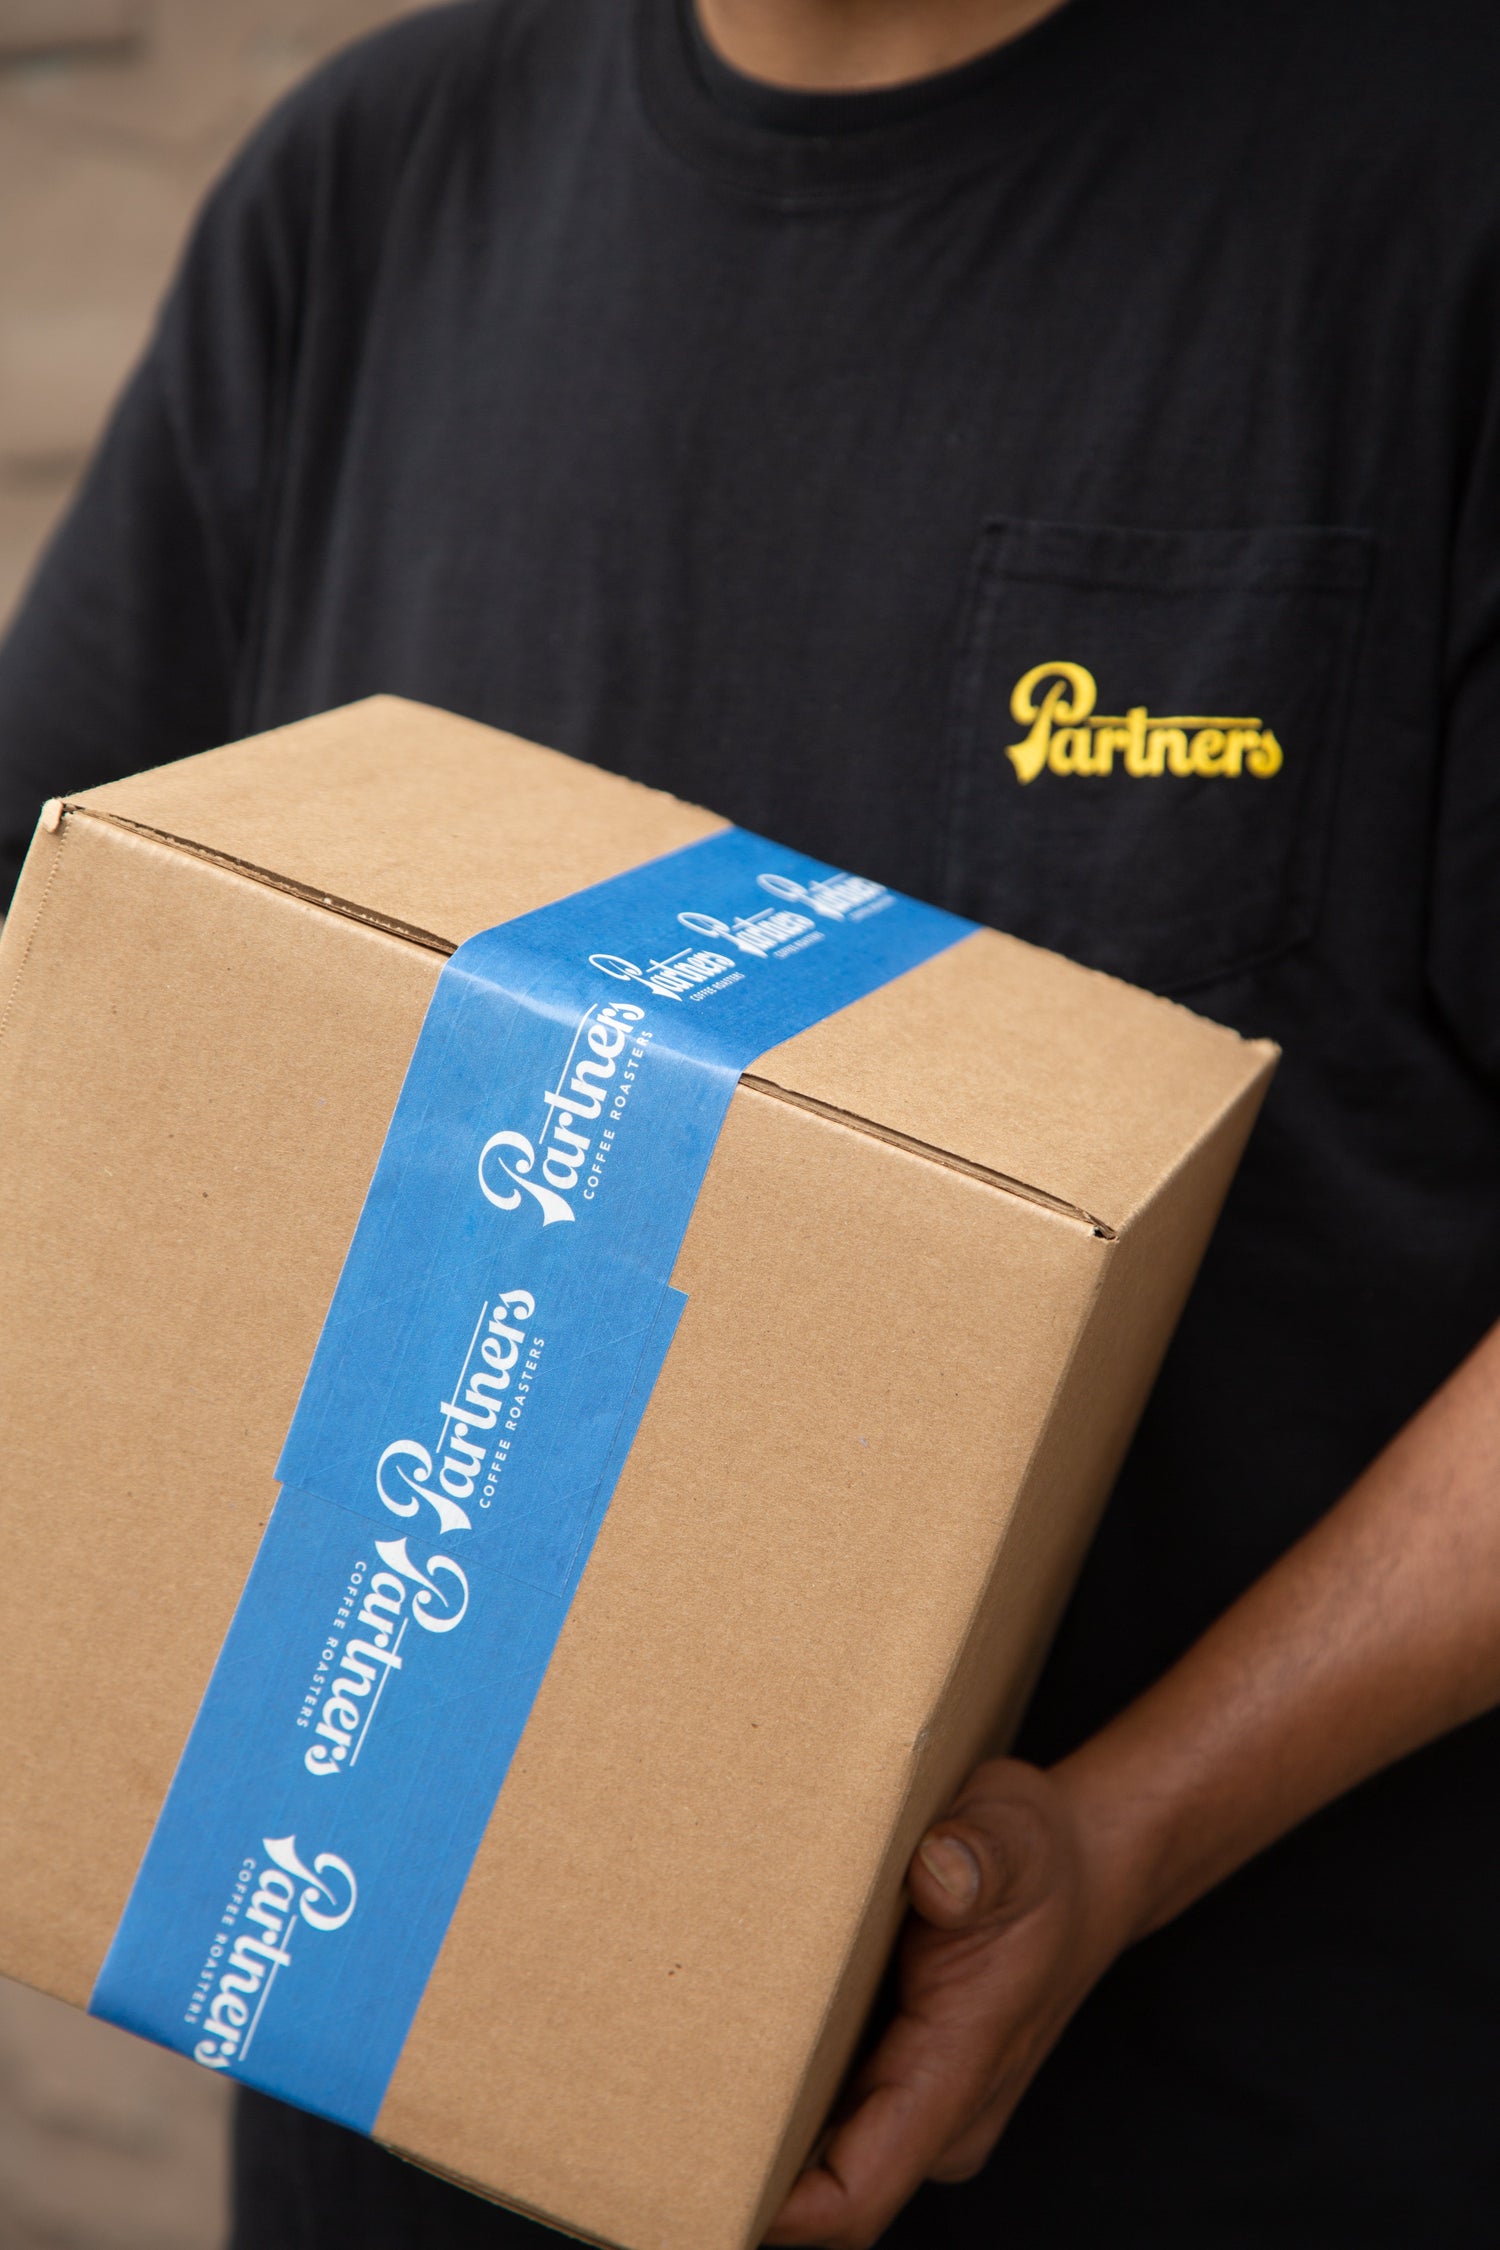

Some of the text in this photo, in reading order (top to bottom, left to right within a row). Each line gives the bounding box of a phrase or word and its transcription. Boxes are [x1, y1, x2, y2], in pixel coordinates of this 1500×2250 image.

[1005, 661, 1283, 786] Partners
[588, 948, 736, 1002] Partners
[677, 907, 815, 959] Partners
[478, 1002, 645, 1227] Partners
[583, 1030, 653, 1200] COFFEE ROASTERS
[376, 1289, 535, 1535] Partners
[479, 1337, 545, 1509] COFFEE ROASTERS
[296, 1561, 367, 1728] COFFEE ROASTERS
[304, 1536, 469, 1776] Partners
[184, 1858, 256, 2024] COFFEE ROASTERS
[194, 1834, 357, 2069] Partners
